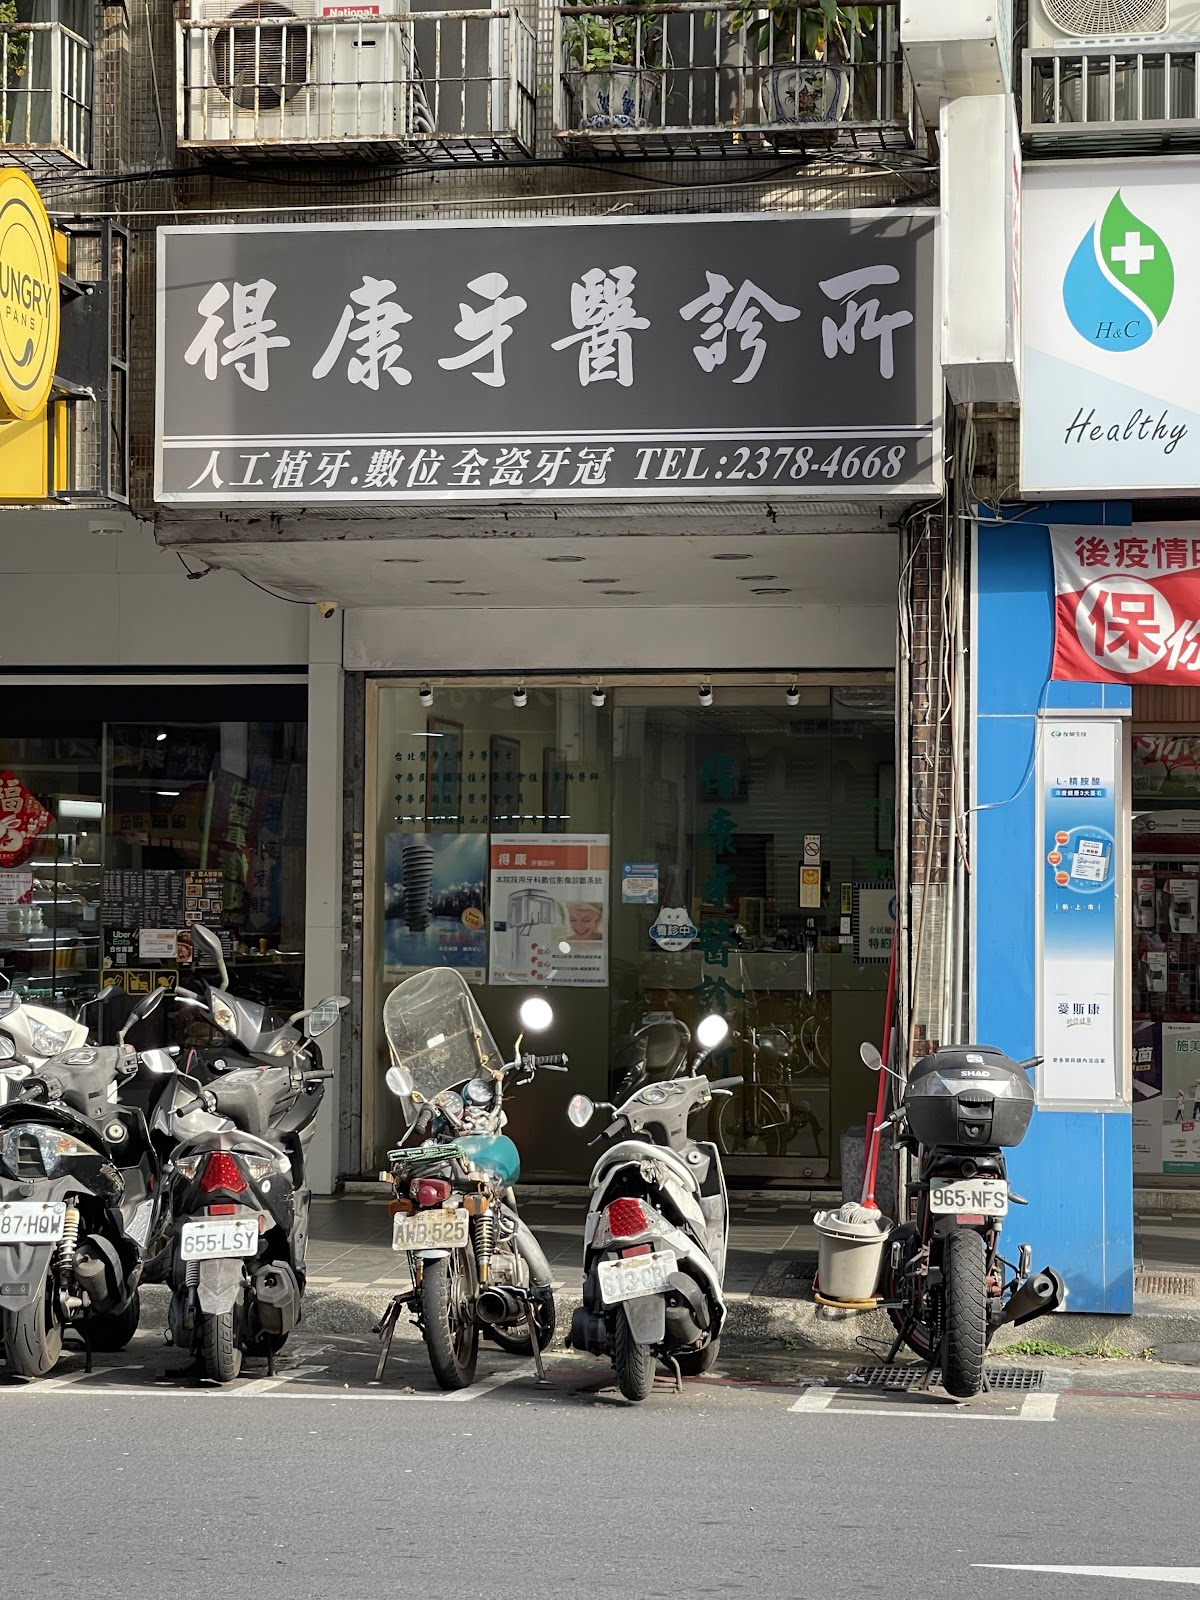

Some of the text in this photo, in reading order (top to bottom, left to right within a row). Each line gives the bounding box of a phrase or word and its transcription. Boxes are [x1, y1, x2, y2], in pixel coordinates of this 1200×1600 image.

[329, 6, 373, 17] National
[6, 305, 35, 331] PANS
[183, 265, 914, 392] 得康牙醫診所
[1095, 320, 1141, 339] H&C
[1064, 407, 1188, 455] Healthy
[634, 444, 906, 481] TEL:2378-4668
[112, 938, 131, 946] Eats
[1057, 1003, 1100, 1015] 愛斯康
